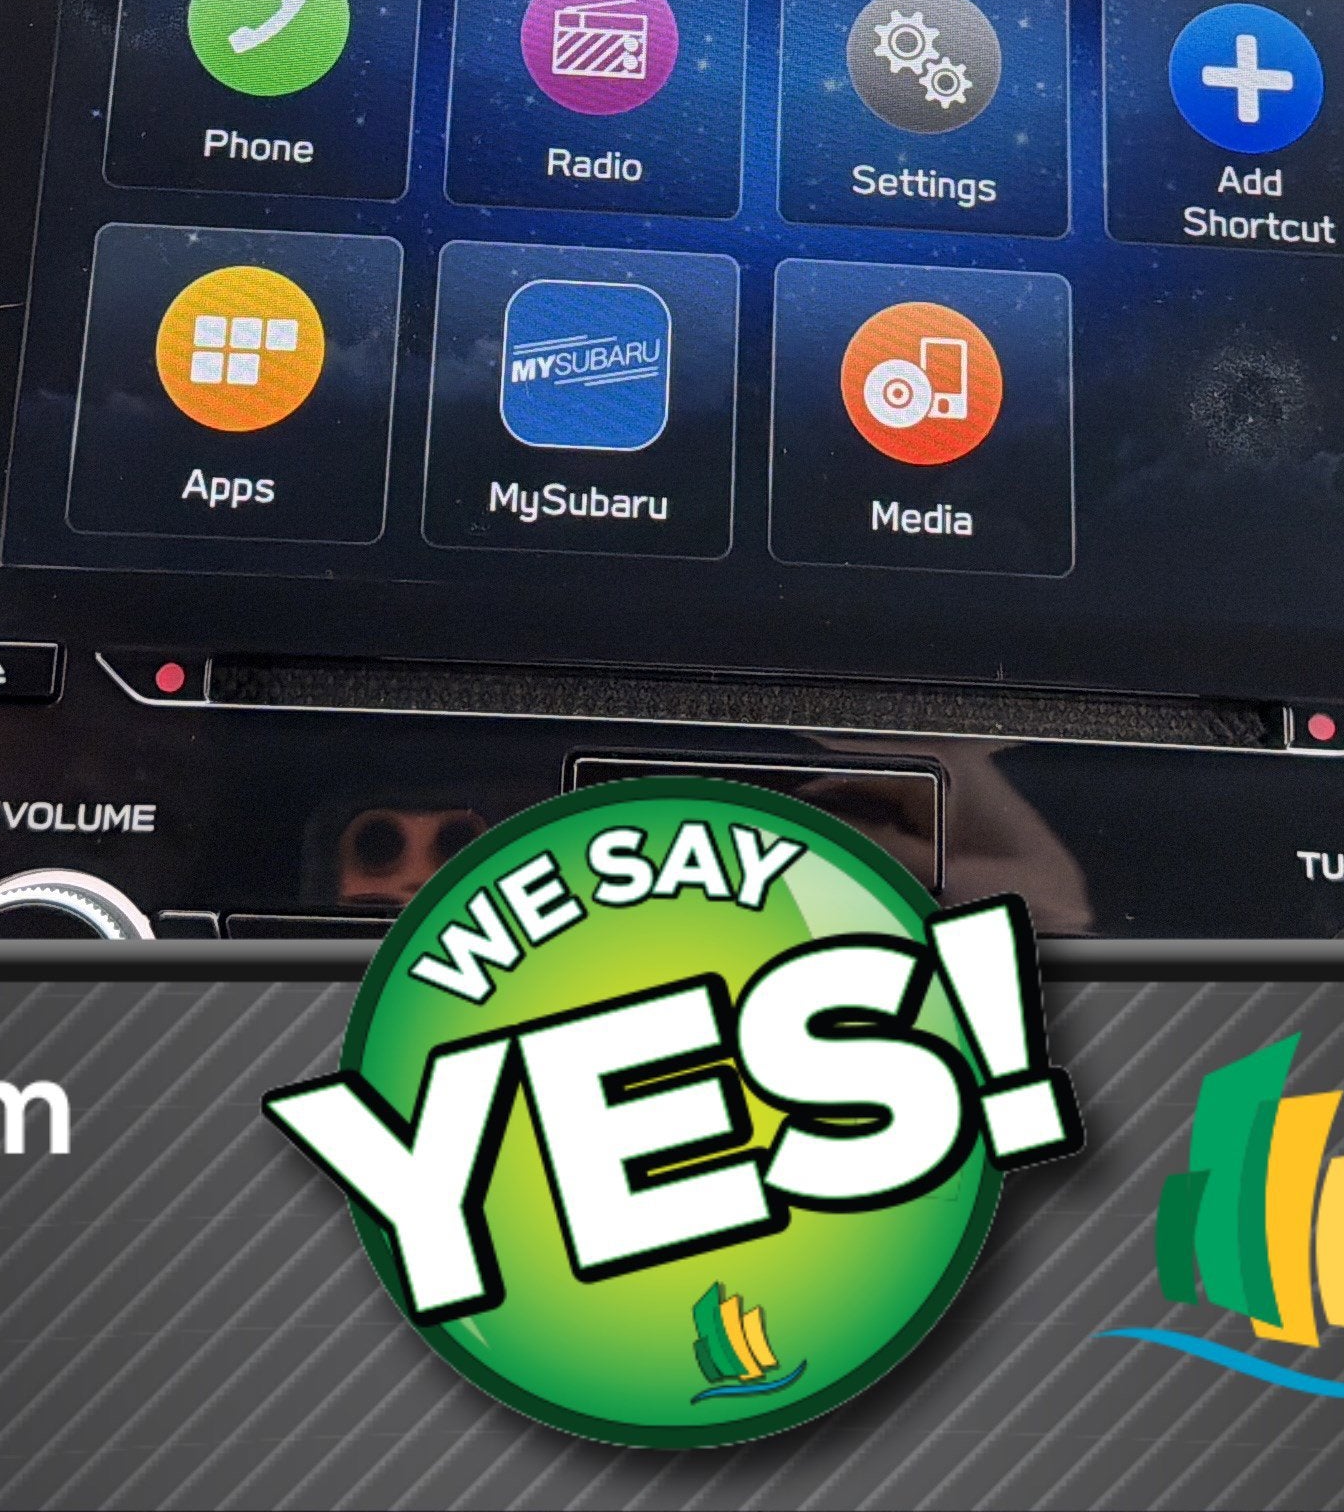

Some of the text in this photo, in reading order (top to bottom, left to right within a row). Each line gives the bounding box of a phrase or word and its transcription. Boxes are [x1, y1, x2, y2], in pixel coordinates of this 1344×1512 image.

[204, 129, 314, 163] Phone
[547, 148, 643, 182] Radio
[1217, 166, 1283, 197] Add
[852, 165, 997, 205] Settings
[1183, 206, 1336, 245] Shortcut
[511, 339, 661, 382] MYSUBARU
[181, 469, 275, 505] Apps
[489, 482, 669, 522] MySubaru
[871, 500, 973, 536] Media
